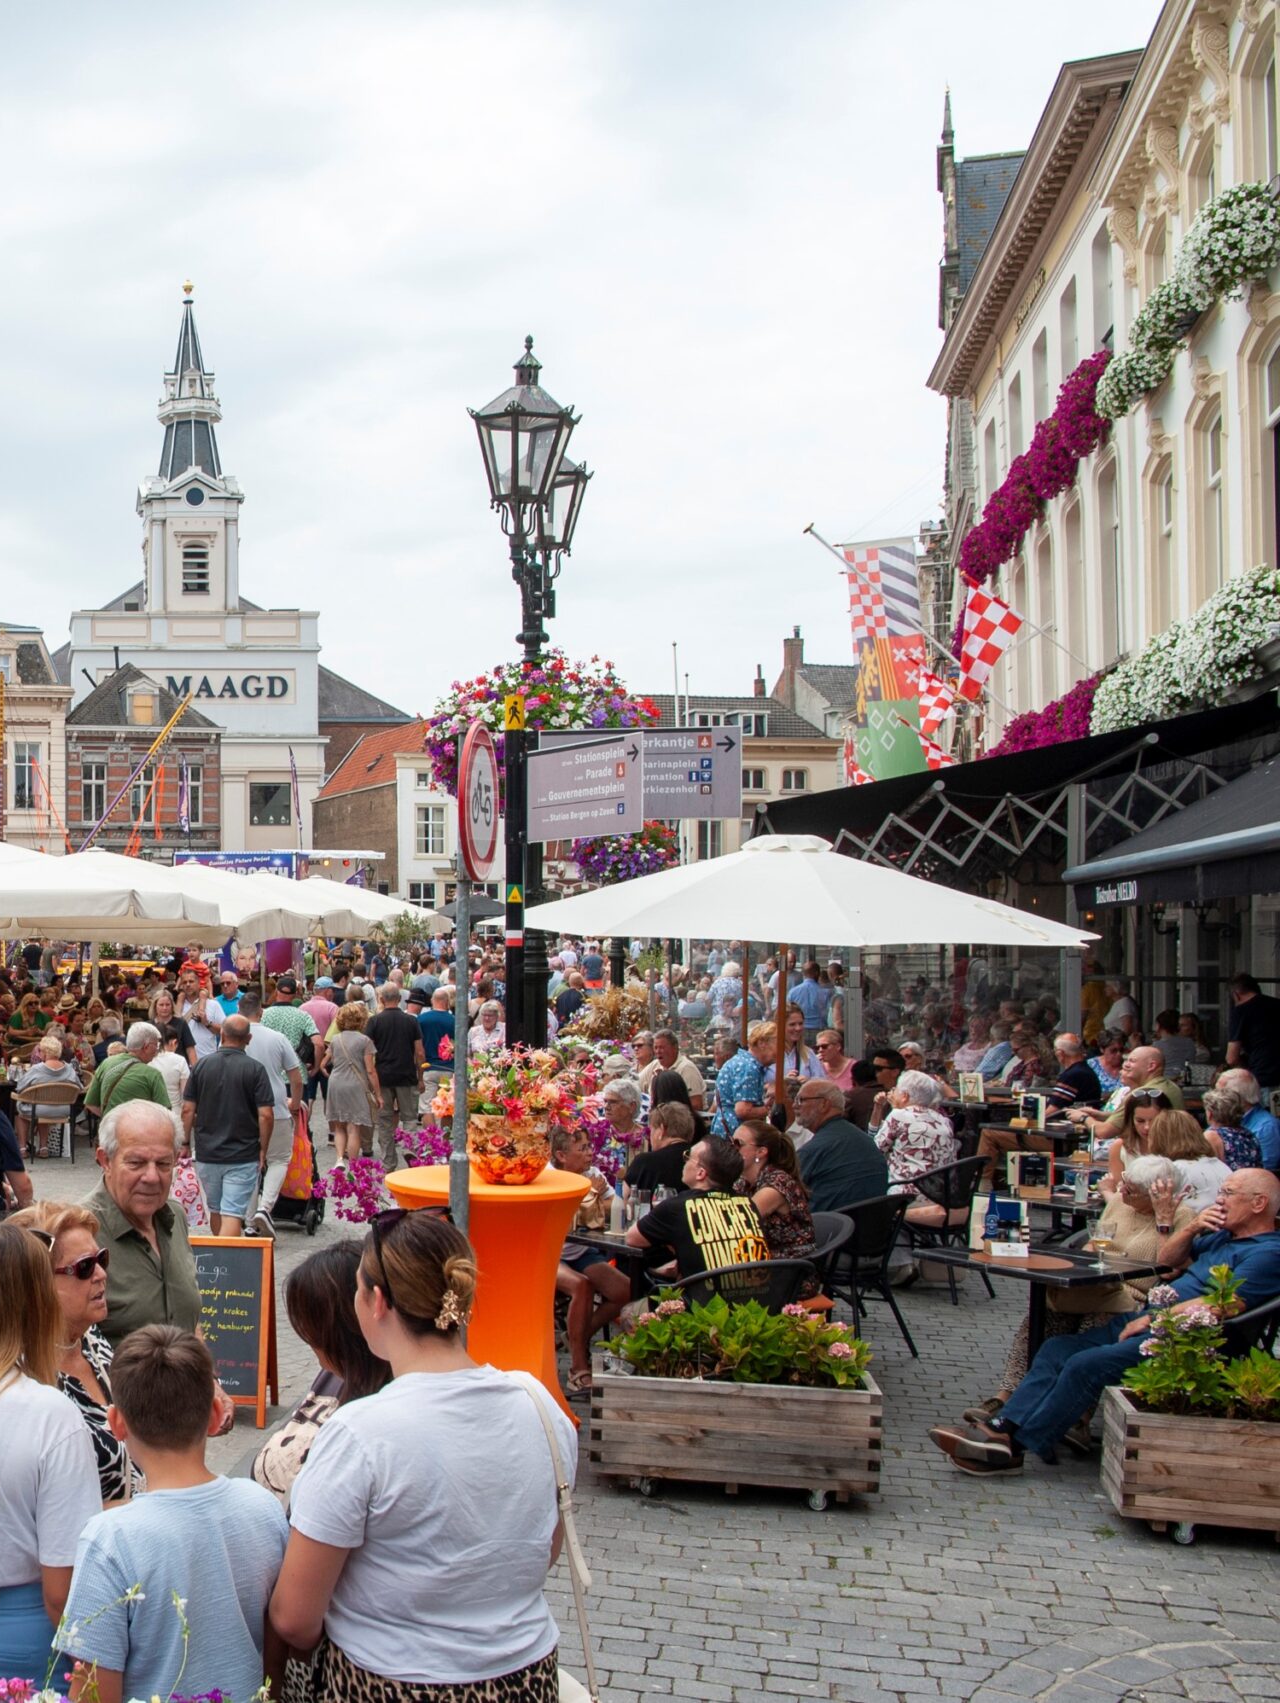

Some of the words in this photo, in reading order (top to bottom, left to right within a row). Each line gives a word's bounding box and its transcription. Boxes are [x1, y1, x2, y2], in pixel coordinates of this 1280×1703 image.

[166, 675, 289, 698] MAAGD
[575, 747, 625, 765] Stationsplein
[585, 766, 613, 779] Parade
[548, 782, 625, 801] Gouvernementsplein
[550, 812, 570, 822] Station
[570, 810, 590, 820] Bergen
[685, 1196, 764, 1245] CONCRETE
[194, 1253, 214, 1274] To
[209, 1266, 228, 1284] go
[199, 1287, 221, 1300] oodje
[201, 1306, 218, 1317] odje
